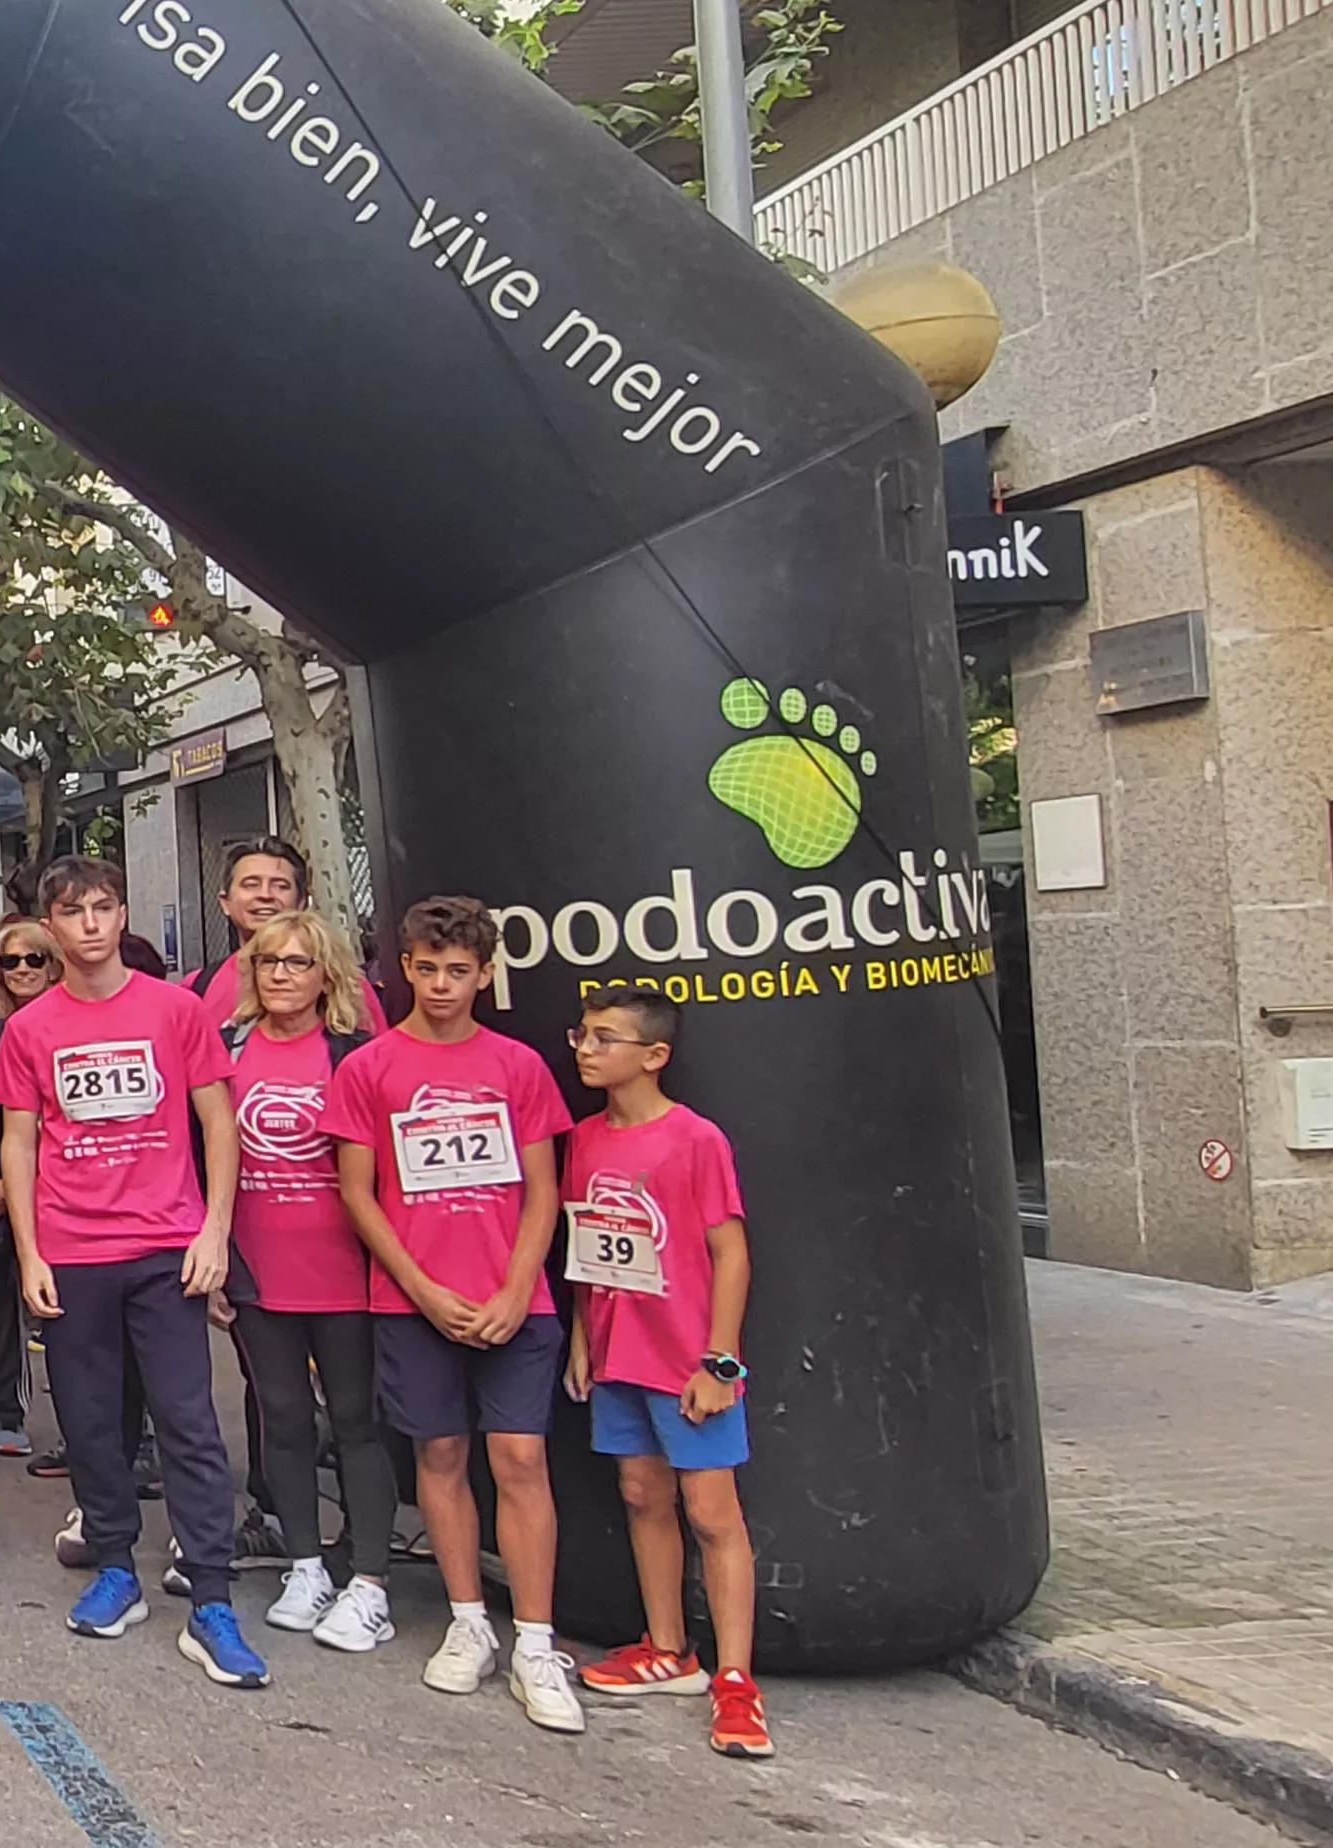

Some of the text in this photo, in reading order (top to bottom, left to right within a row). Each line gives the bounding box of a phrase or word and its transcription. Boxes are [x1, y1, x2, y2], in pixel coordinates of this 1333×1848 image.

[226, 51, 381, 224] bien,
[408, 196, 540, 322] vive
[540, 307, 762, 474] mejor
[831, 965, 851, 994] Y
[64, 1067, 147, 1101] 2815
[419, 1133, 493, 1167] 212
[596, 1233, 635, 1266] 39
